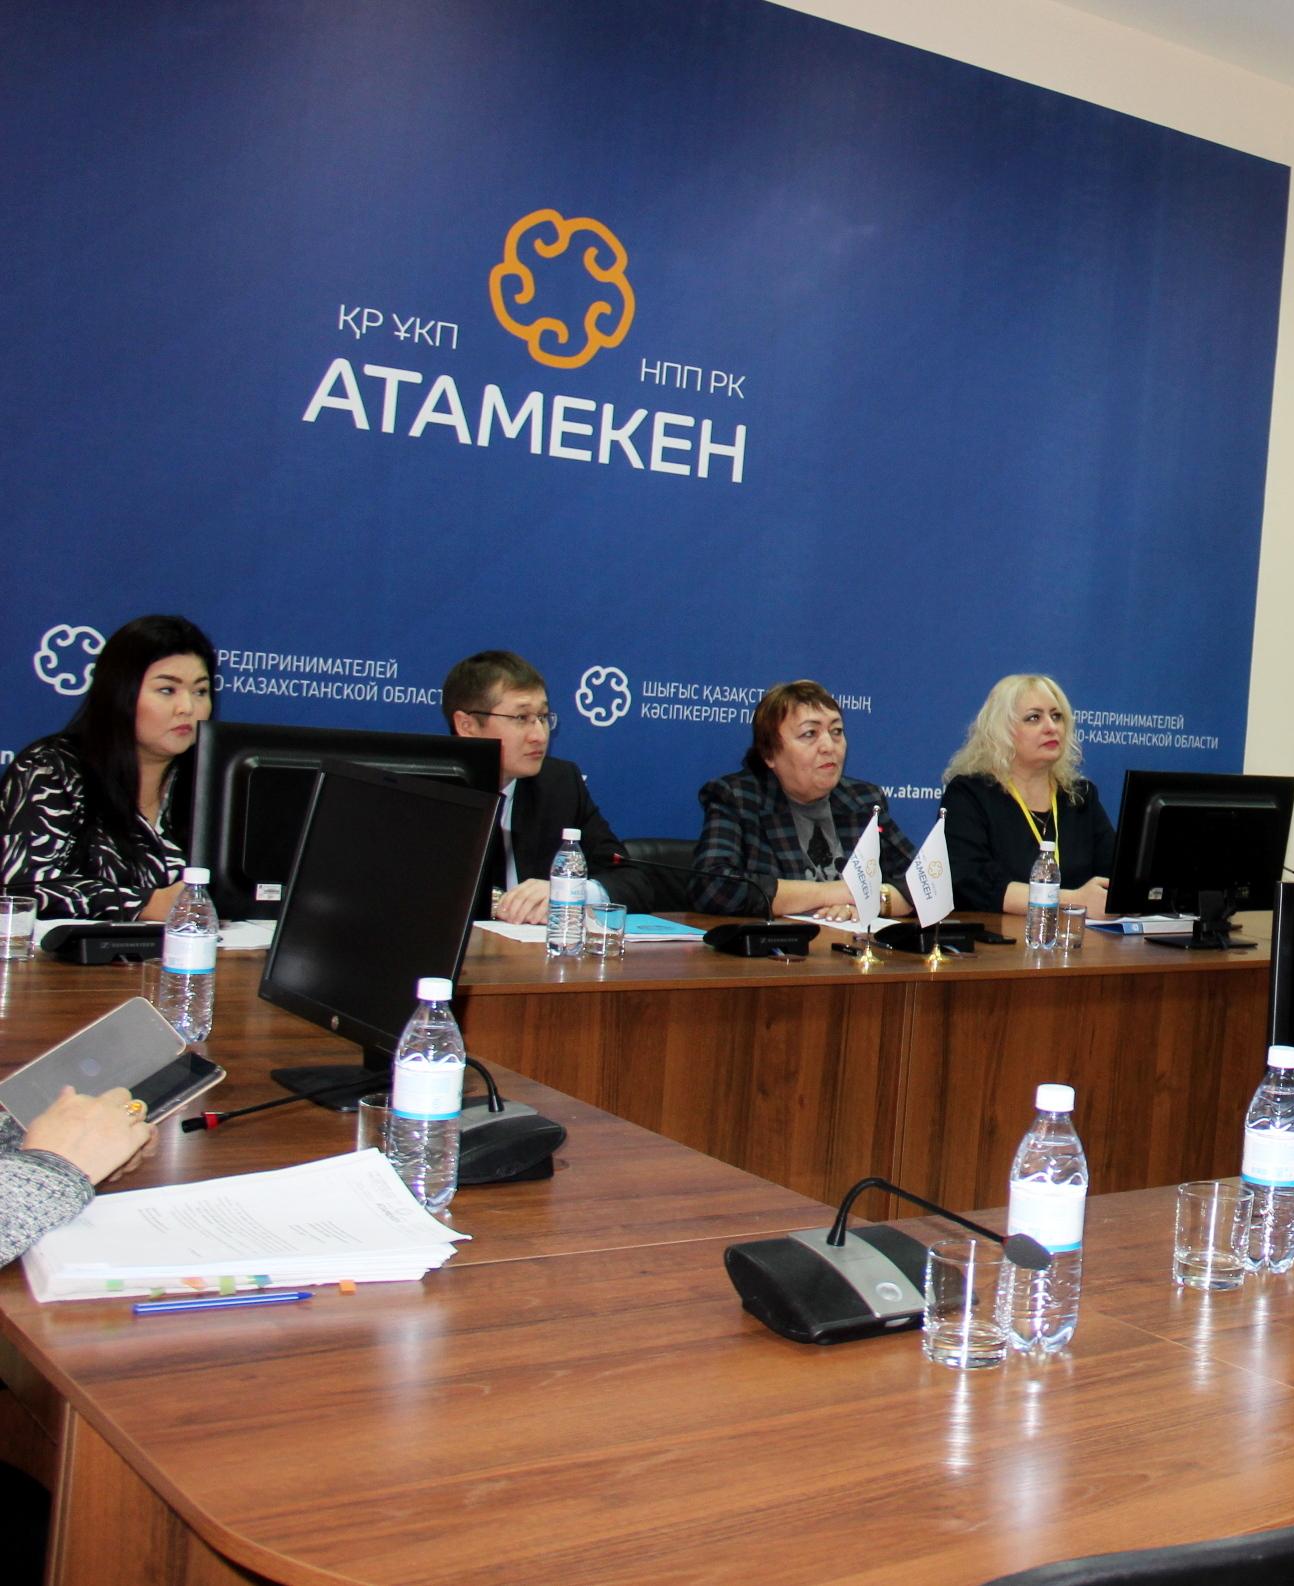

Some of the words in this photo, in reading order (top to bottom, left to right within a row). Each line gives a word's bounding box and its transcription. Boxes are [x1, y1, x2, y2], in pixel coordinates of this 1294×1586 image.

[338, 304, 384, 339] ҚР
[392, 313, 459, 350] ҰКП
[640, 358, 703, 391] НПП
[709, 370, 746, 398] РК
[302, 358, 747, 483] АТАМЕКЕН
[214, 649, 398, 679] РЕДПРИНИМАТЕЛЕЙ
[213, 674, 378, 702] О-КАЗАХСТАНСКОЙ
[383, 686, 444, 705] ОБЛАСТ
[643, 681, 700, 700] ШЫҒЫС
[703, 685, 768, 706] ҚАЗАҚСТ
[641, 703, 737, 723] КӘСІПКЕРЛЕР
[1074, 729, 1172, 747] О-КАЗАХСТАНСКОЙ
[1174, 734, 1219, 750] ОБЛАСТИ
[881, 784, 946, 800] w.atame
[850, 853, 870, 900] ТАМЕКЕН
[914, 855, 934, 900] ТАМЕКЕН
